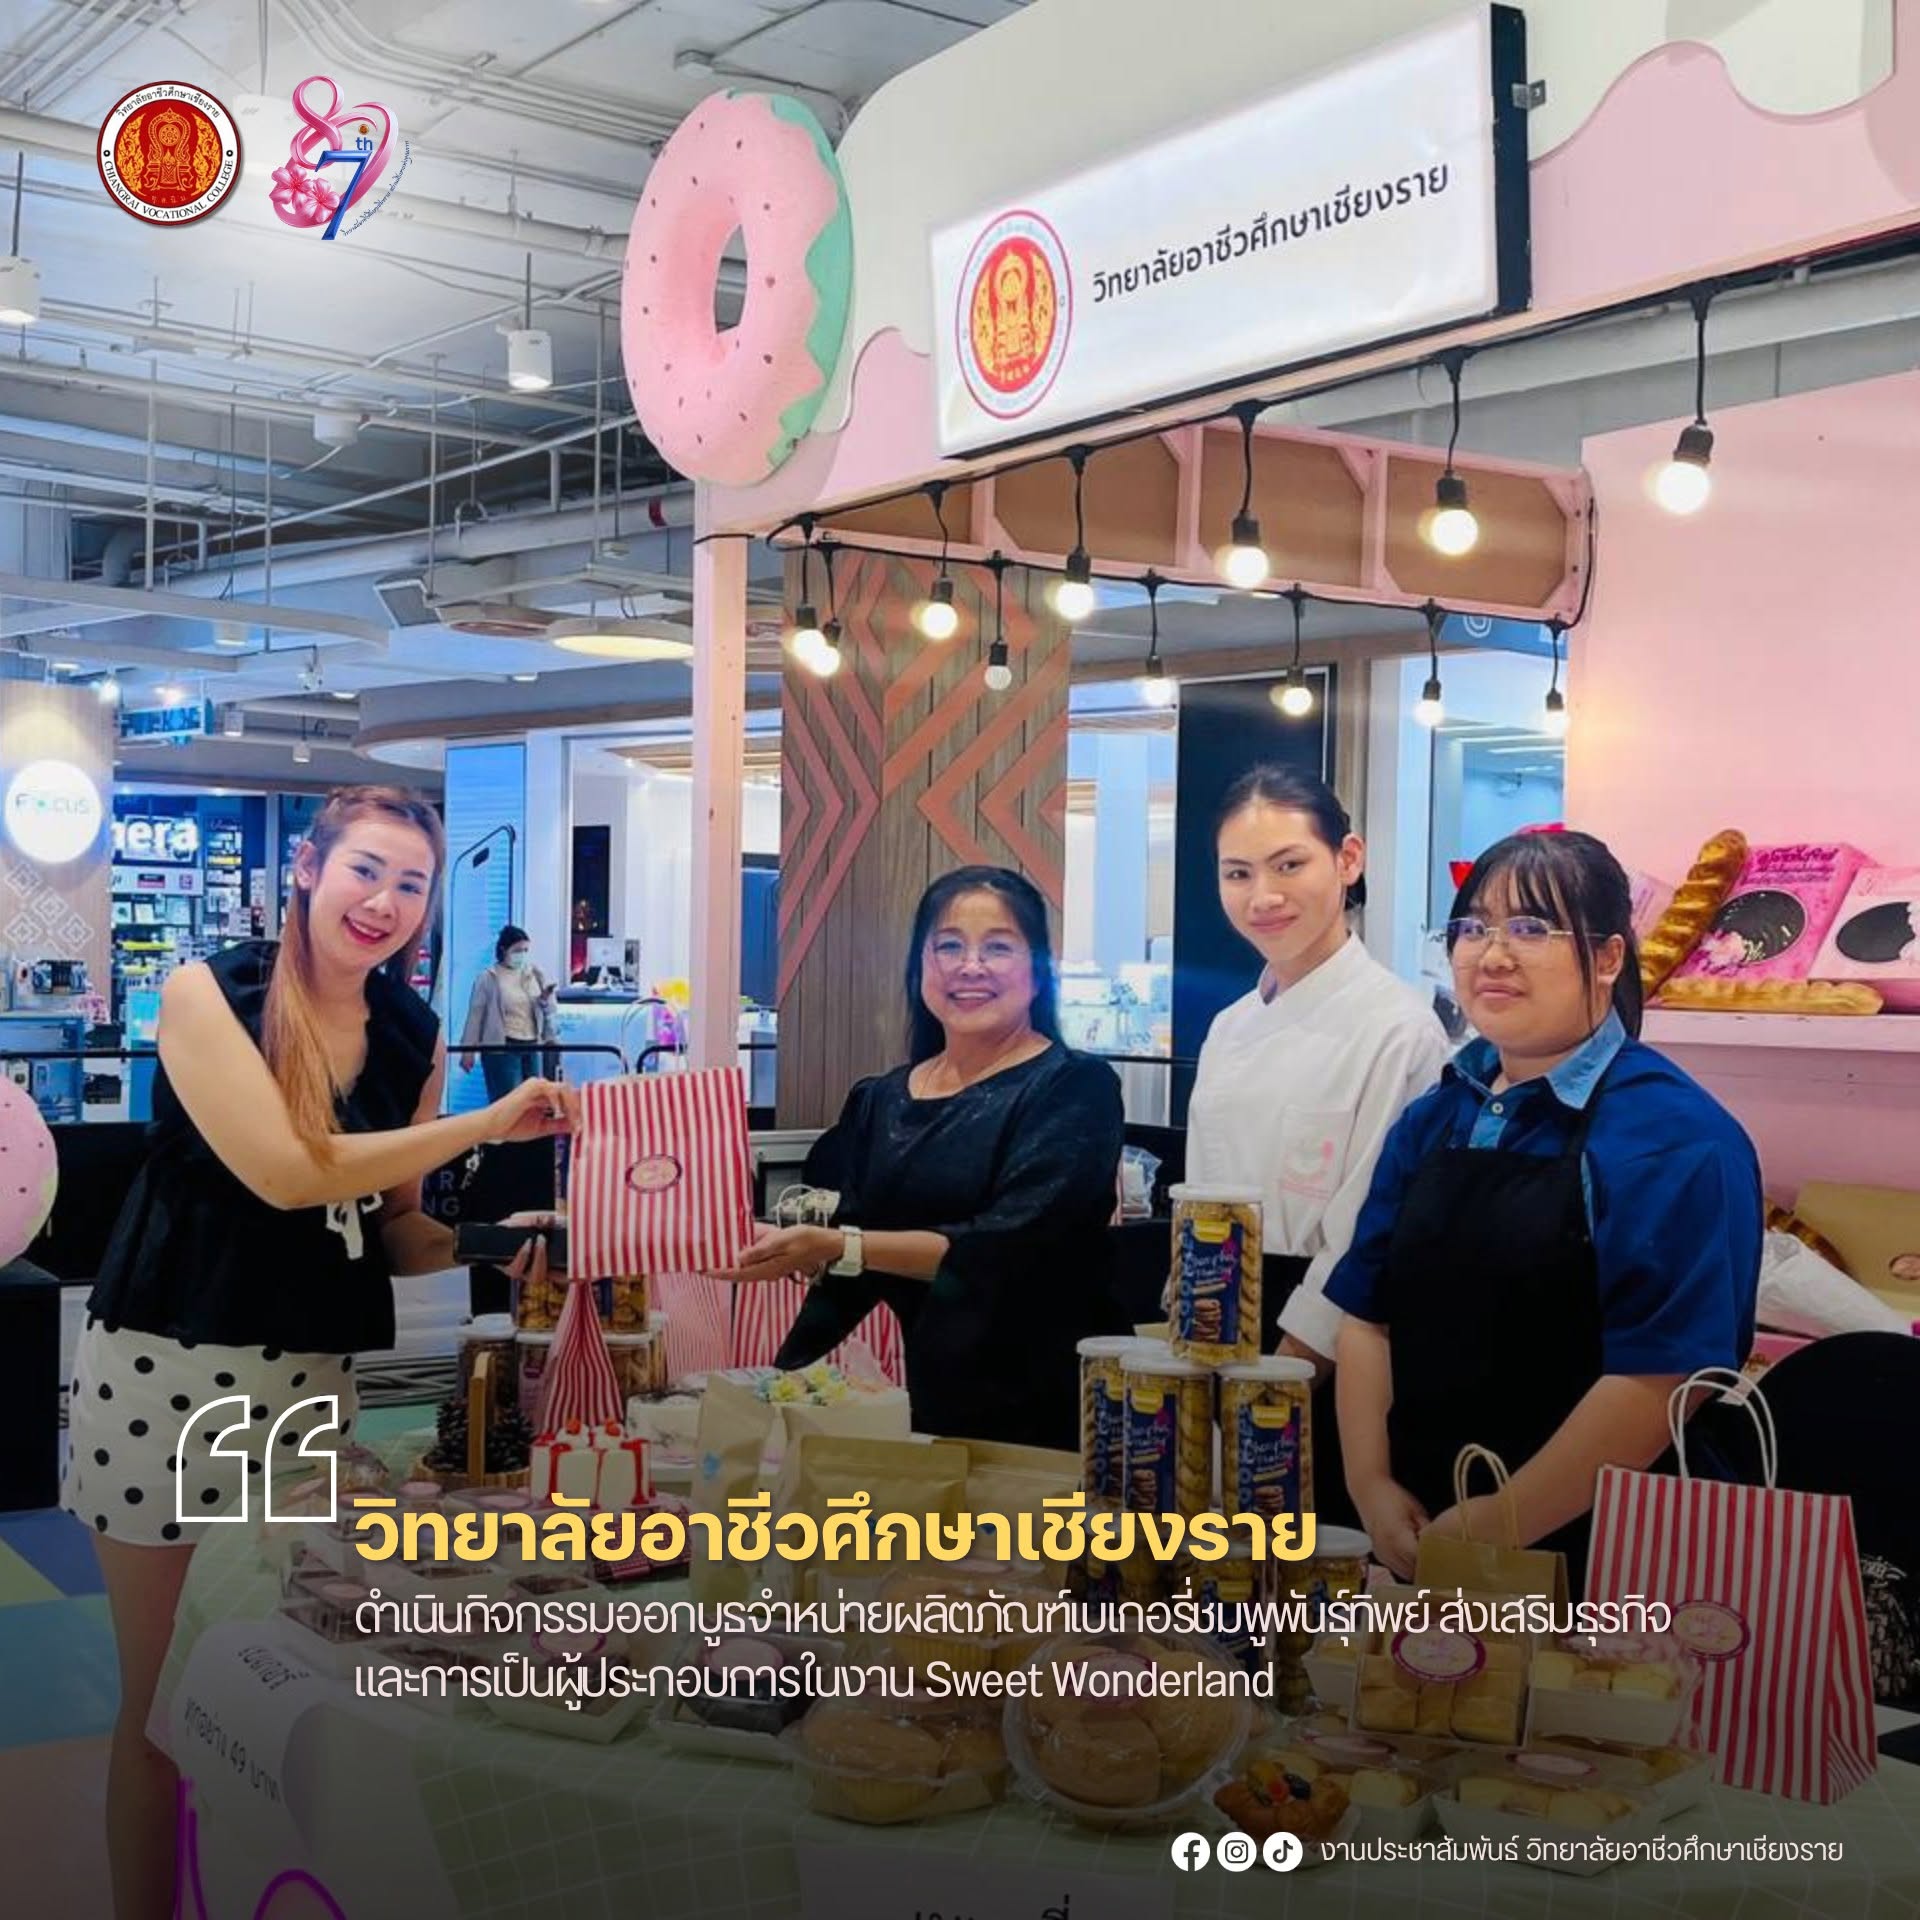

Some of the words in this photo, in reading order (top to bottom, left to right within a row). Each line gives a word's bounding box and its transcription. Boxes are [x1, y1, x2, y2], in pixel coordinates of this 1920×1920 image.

[1093, 163, 1449, 303] วิทยาลัยอาชีวศึกษาเชียงราย
